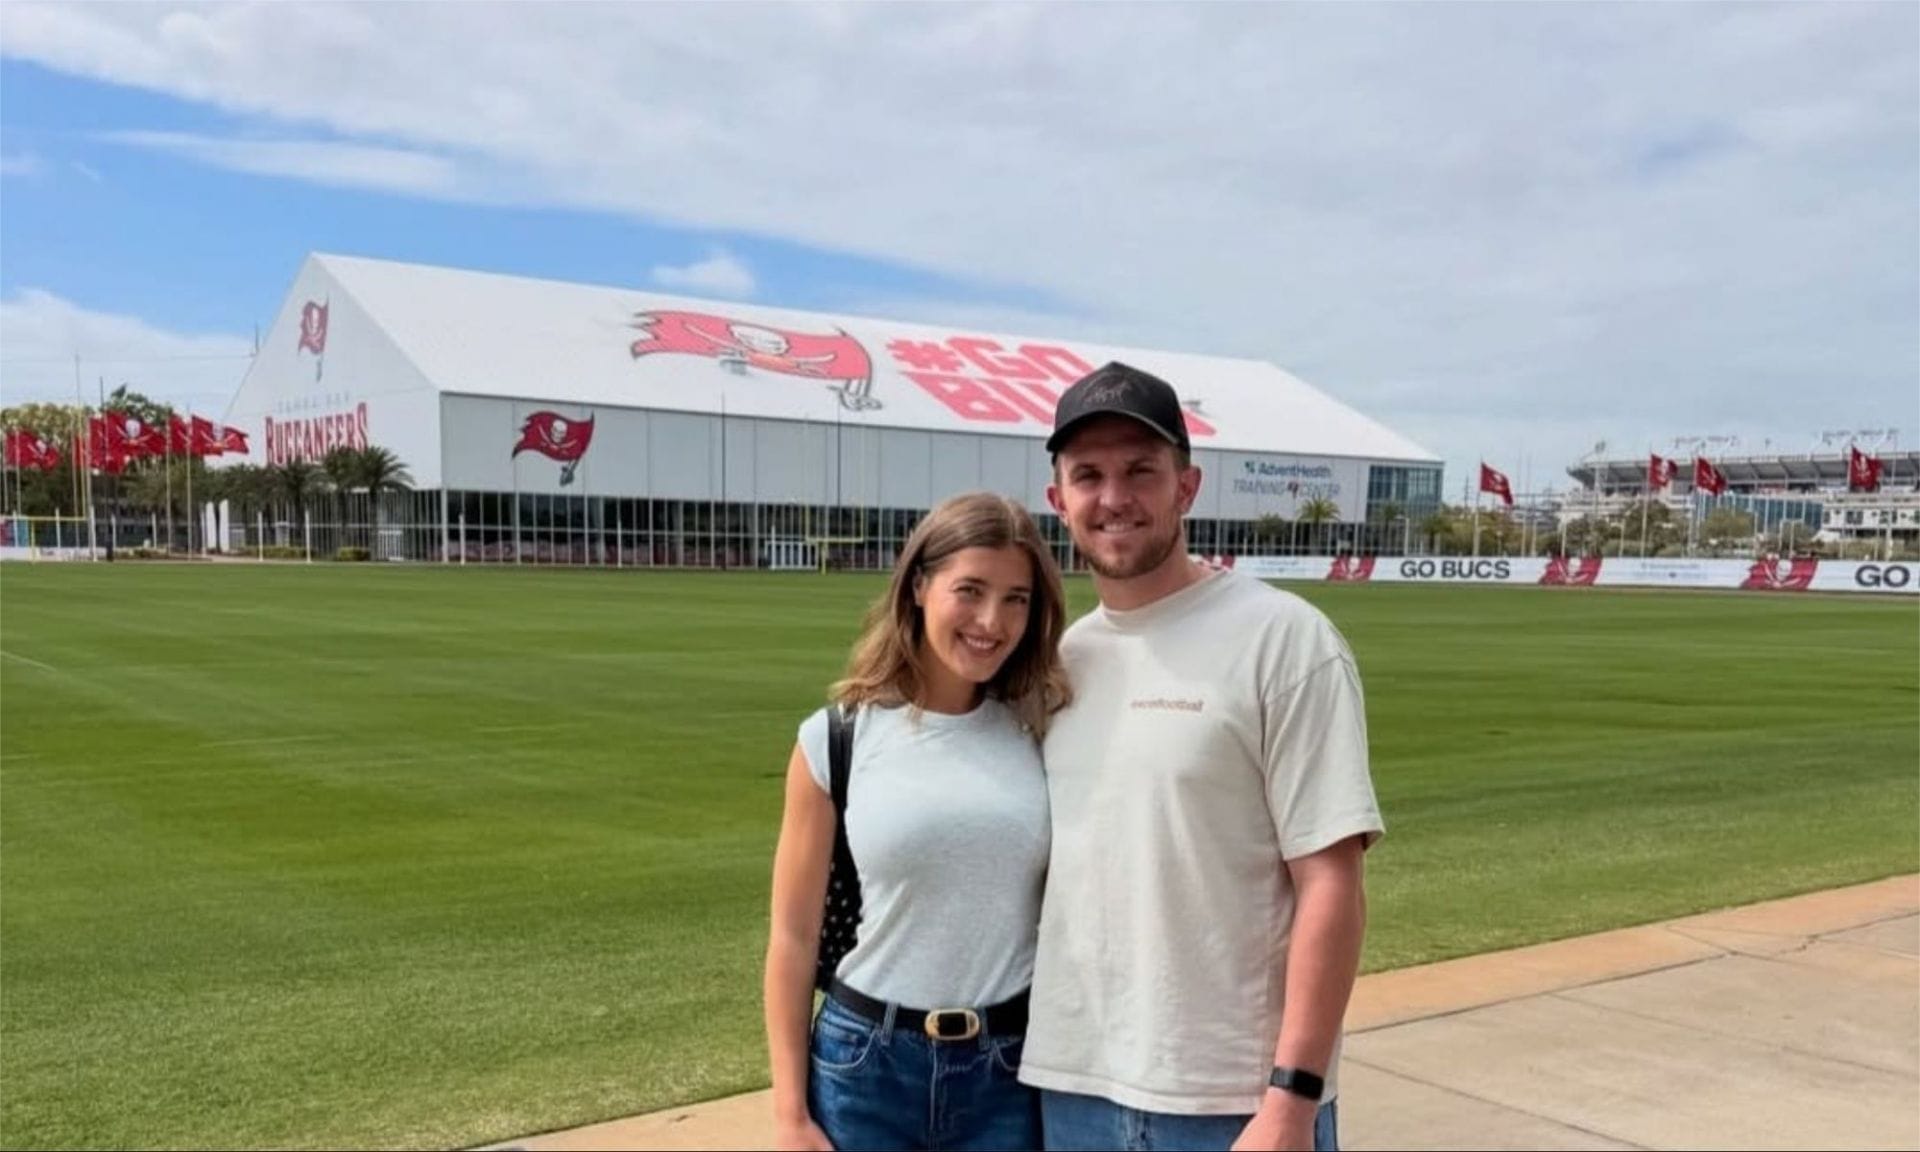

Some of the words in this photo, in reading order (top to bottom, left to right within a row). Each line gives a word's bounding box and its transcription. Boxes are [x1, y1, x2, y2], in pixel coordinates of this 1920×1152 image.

[1259, 462, 1331, 478] AdventHealth
[1233, 479, 1286, 496] TRAINING
[1400, 560, 1436, 579] GO
[1442, 560, 1510, 580] BUCS
[1856, 564, 1910, 588] GO
